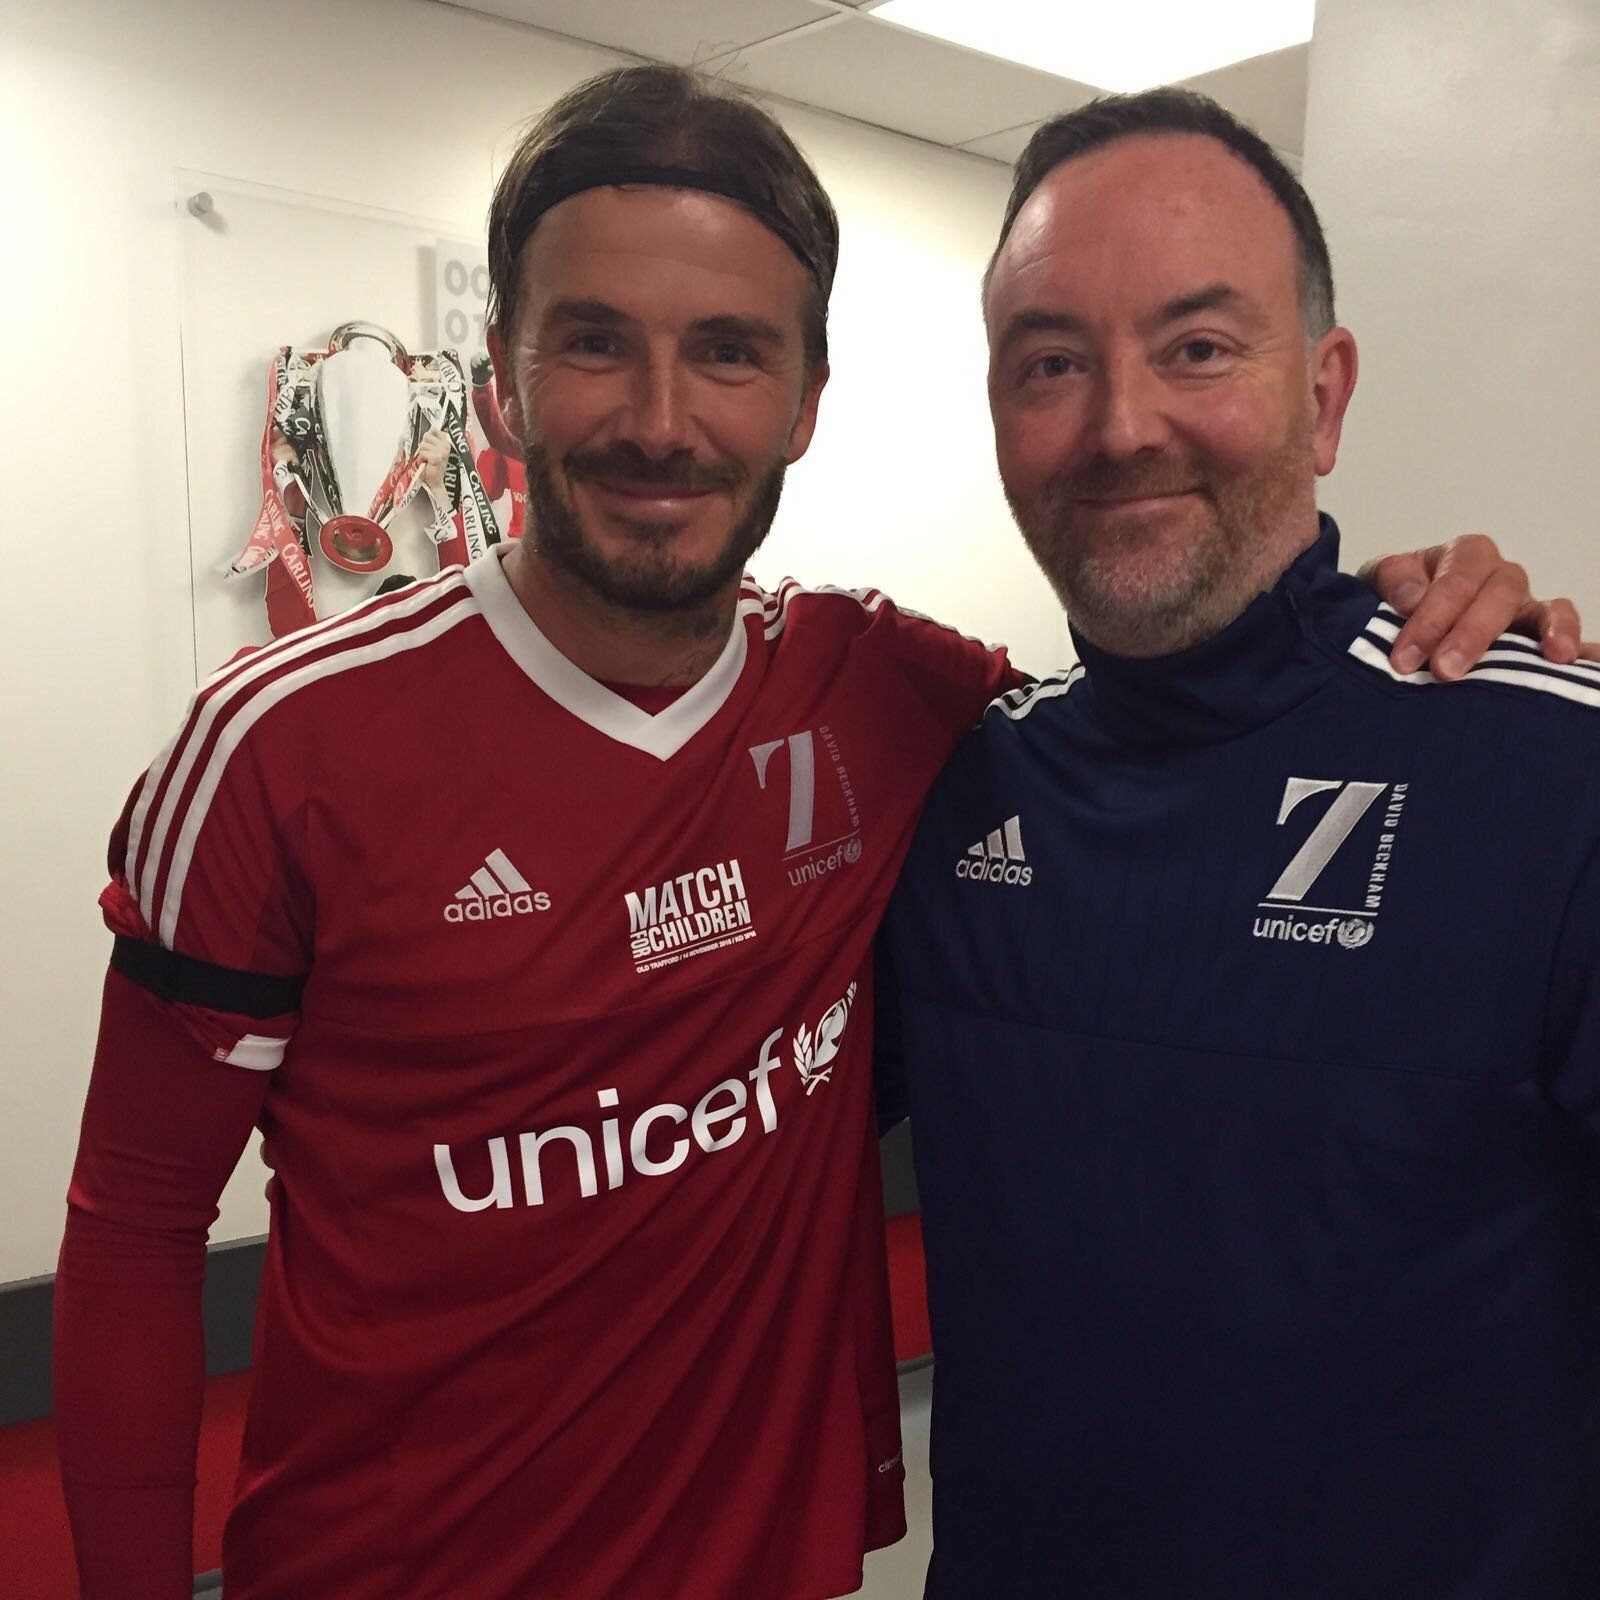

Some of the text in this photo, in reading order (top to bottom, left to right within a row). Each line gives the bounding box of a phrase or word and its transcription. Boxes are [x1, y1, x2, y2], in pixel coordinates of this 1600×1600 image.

[463, 494, 483, 560] CARLING
[469, 470, 496, 535] CARLING
[819, 726, 861, 827] DAVID BECKHAM
[788, 844, 846, 886] unicef
[956, 855, 1033, 886] adidas
[1364, 783, 1408, 908] DAVID BECKHAM
[443, 891, 552, 922] adidas
[624, 859, 746, 933] MATCH
[630, 900, 752, 959] FOR CHILDREN
[1252, 914, 1340, 945] unicef
[433, 1027, 784, 1213] unicef
